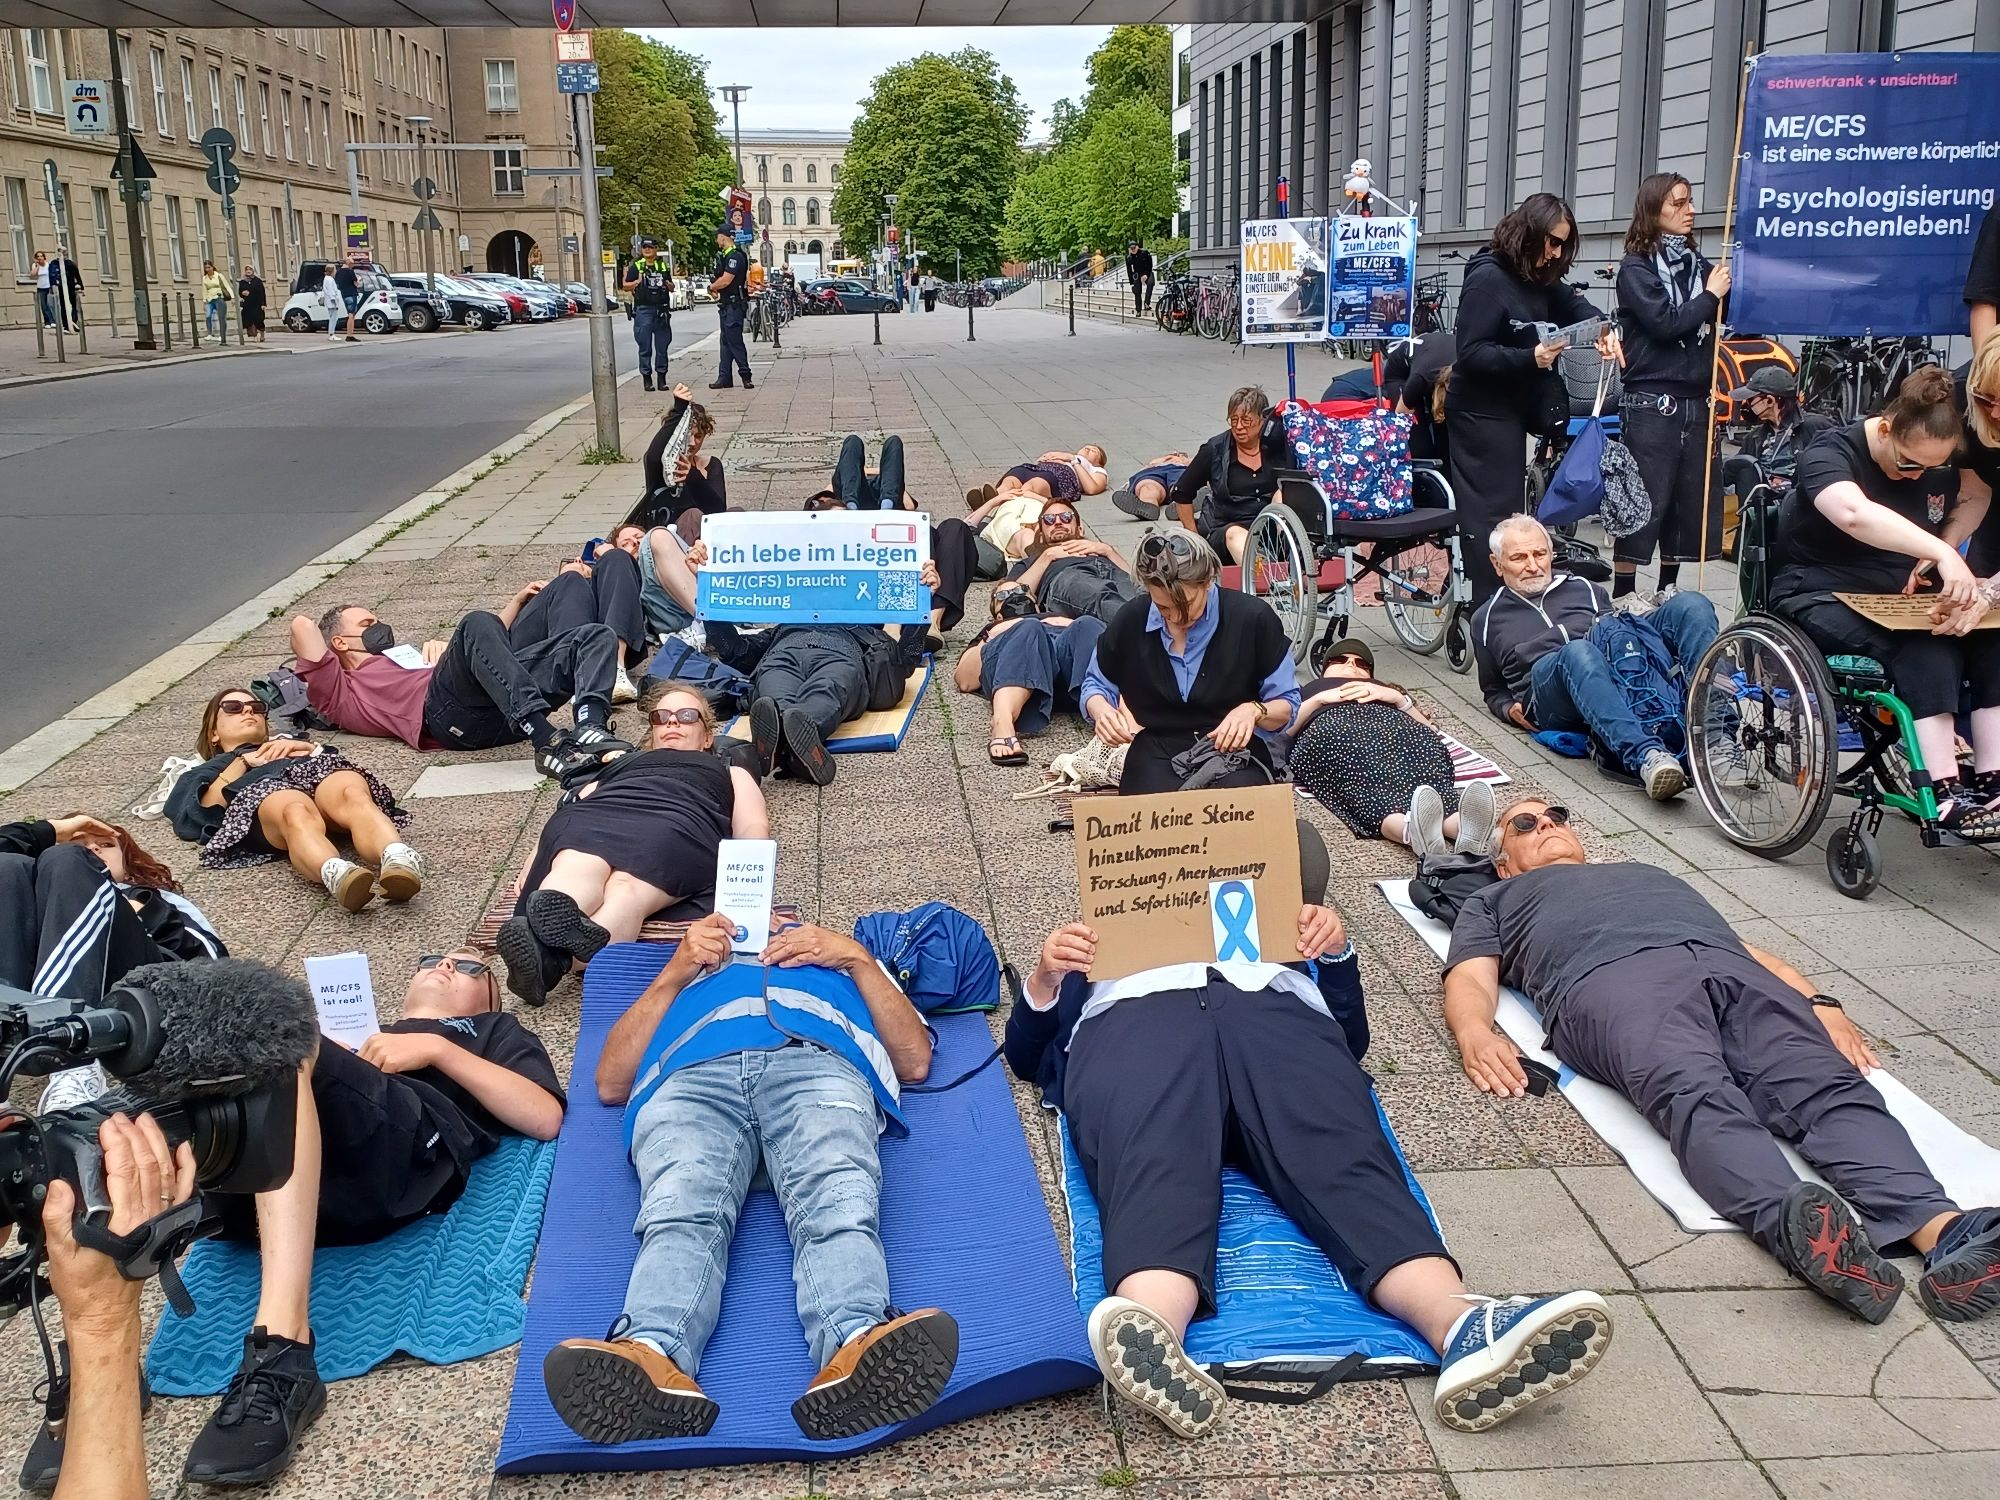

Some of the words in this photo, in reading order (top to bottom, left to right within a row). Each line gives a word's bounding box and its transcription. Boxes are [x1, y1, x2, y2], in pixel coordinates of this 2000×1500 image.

[75, 83, 97, 96] dm
[1767, 75, 1864, 90] schwerkrank
[1867, 79, 1876, 87] +
[1880, 73, 1958, 87] unsichtbar!
[1764, 114, 1866, 140] ME/CFS
[1762, 145, 1786, 163] ist
[1790, 144, 1831, 162] eine
[1835, 143, 1918, 162] schwere
[1758, 184, 1995, 214] Psychologisierung
[1245, 225, 1278, 237] ME/CFS
[1339, 222, 1360, 241] Zu
[1755, 213, 1971, 237] Menschenleben!
[1342, 242, 1365, 253] zum
[1368, 240, 1400, 251] Leben
[1245, 242, 1297, 272] KEINE
[1353, 257, 1391, 268] ME/CFS
[1245, 273, 1265, 283] FRAGE
[1267, 272, 1280, 282] DER
[1245, 282, 1290, 294] EINSTELLUNG!
[712, 545, 745, 564] Ich
[752, 544, 801, 563] lebe
[808, 543, 835, 562] im
[843, 543, 917, 567] Liegen
[711, 574, 782, 591] ME/(CFS)
[786, 573, 847, 588] braucht
[710, 592, 791, 609] Forschung
[1086, 811, 1142, 841] Damit
[1150, 807, 1194, 831] keine
[1201, 803, 1255, 825] Steine
[1088, 837, 1209, 868] hinzukommen!
[726, 863, 764, 872] ME/CFS
[726, 875, 738, 883] ist
[741, 875, 763, 883] real!
[1089, 871, 1173, 892] Forschung,
[1176, 862, 1266, 881] Anerkennung
[1093, 900, 1126, 918] und
[321, 983, 361, 994] ME/CFS
[339, 995, 363, 1005] real!
